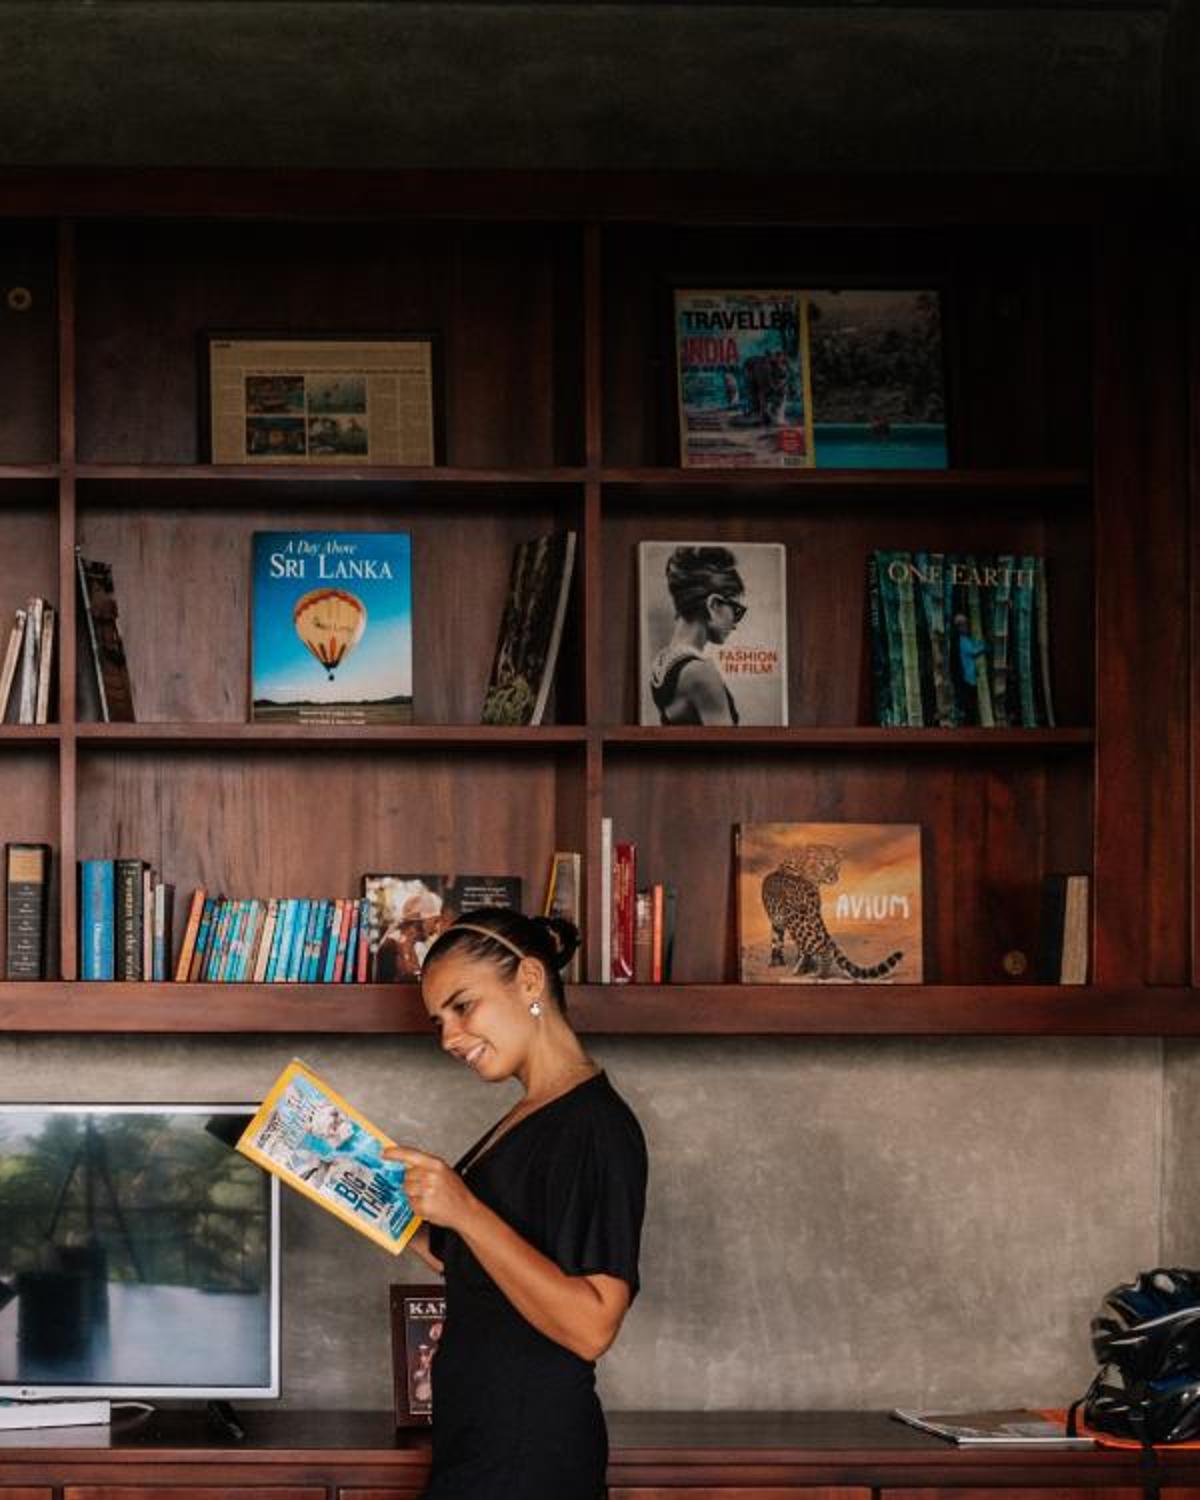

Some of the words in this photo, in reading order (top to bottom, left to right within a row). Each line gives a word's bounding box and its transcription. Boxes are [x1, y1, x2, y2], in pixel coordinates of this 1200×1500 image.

[285, 540, 294, 554] A
[296, 540, 319, 556] Day
[270, 553, 306, 579] SRI
[319, 554, 394, 580] LANKA
[887, 560, 942, 585] ONE
[951, 562, 1035, 588] EARTH
[718, 649, 778, 663] FASHION
[725, 662, 738, 675] IN
[741, 662, 774, 675] FILM
[836, 893, 911, 921] AVIUM
[334, 1171, 367, 1204] BIG
